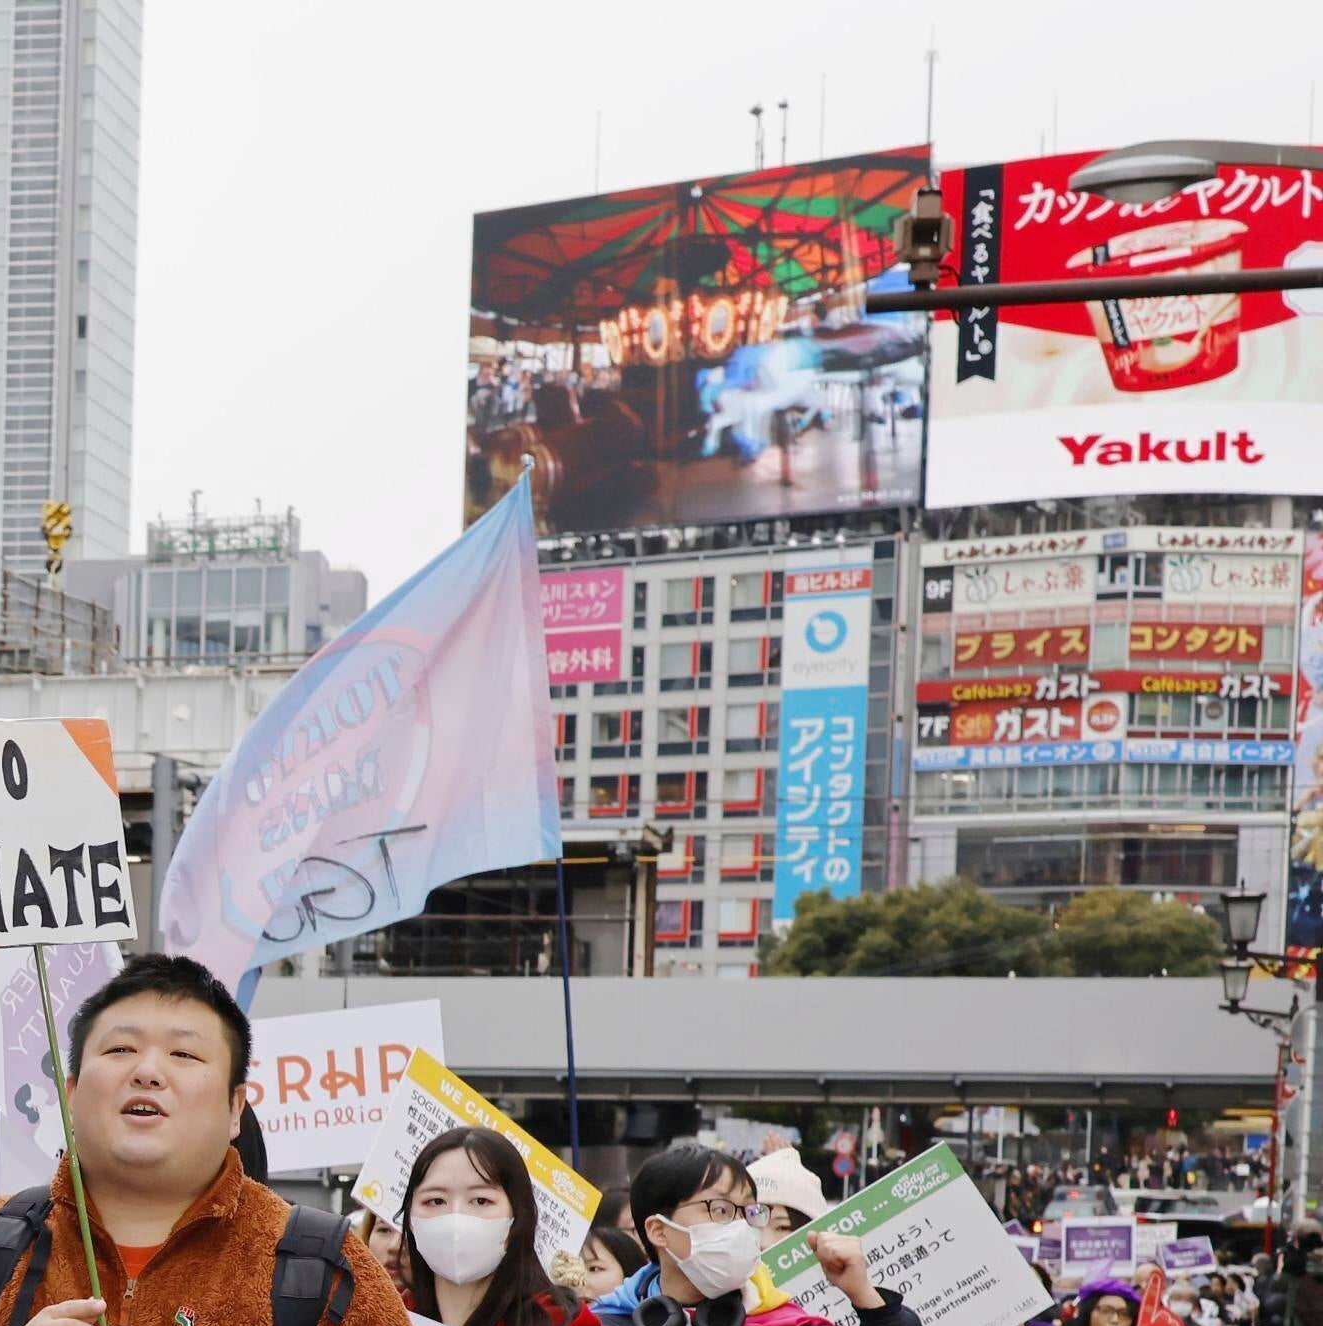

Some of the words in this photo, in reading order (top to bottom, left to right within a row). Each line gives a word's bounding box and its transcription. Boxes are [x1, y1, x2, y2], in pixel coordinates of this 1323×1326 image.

[1058, 431, 1265, 466] Yakult
[925, 580, 953, 600] 9F
[1130, 626, 1259, 655] コンタクト
[1035, 673, 1101, 701] ガスト
[1219, 673, 1281, 700] ガスト
[918, 715, 950, 738] 7F
[994, 706, 1076, 742] ガスト
[785, 716, 826, 884] アイシティ
[823, 715, 855, 883] コンタクトの
[313, 1103, 390, 1129] Allia
[407, 1104, 444, 1136] 性自認
[410, 1088, 460, 1129] SOGIに基
[439, 1078, 461, 1105] WE
[464, 1096, 498, 1131] CALL
[406, 1122, 432, 1144] 暴力
[394, 1150, 412, 1169] Enac
[777, 1242, 816, 1270] CAL
[827, 1208, 868, 1234] FOR
[915, 1293, 943, 1316] riage
[944, 1286, 955, 1299] in
[956, 1264, 990, 1292] Japan!
[934, 1278, 1001, 1324] partnerships.
